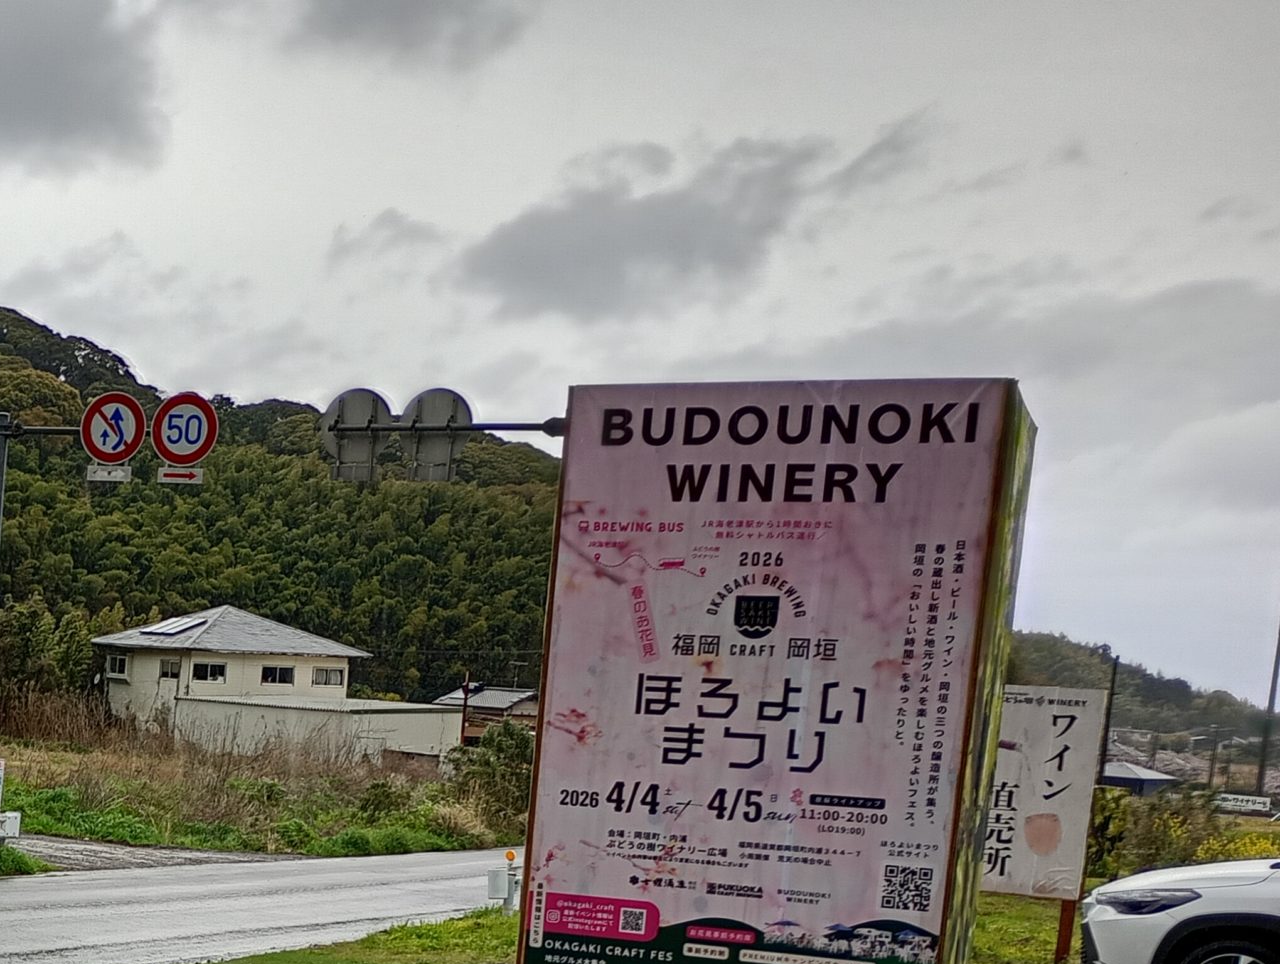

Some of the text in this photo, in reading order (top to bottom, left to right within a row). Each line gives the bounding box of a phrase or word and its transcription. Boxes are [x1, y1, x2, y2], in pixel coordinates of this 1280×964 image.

[166, 413, 203, 445] 50
[601, 402, 981, 447] BUDOUNOKI
[666, 462, 903, 504] WINERY
[593, 521, 684, 533] BREWING BUS
[738, 551, 784, 567] 2026
[706, 573, 807, 618] OKAGAKI BREWING
[631, 585, 656, 657] 春のお花見
[672, 633, 839, 661] 福岡 CRAFT 岡垣
[635, 673, 867, 725] ほろよい
[1047, 698, 1088, 708] WINERY
[661, 722, 826, 774] まつり
[1042, 713, 1079, 801] ワイン
[559, 789, 600, 808] 2026
[605, 781, 660, 815] 4/4
[706, 787, 764, 823] 4/5
[770, 793, 778, 803] 日
[799, 808, 888, 825] 11:00-20:00
[983, 781, 1020, 877] 直売所
[817, 824, 866, 836] (LO19:00)
[606, 840, 728, 858] ぶどうの樹ワイナリー広場
[880, 840, 939, 851] ほろよいまつり
[717, 882, 764, 894] FUKUOKA
[776, 888, 832, 899] BUDOUNOKI
[786, 896, 820, 905] WINERY
[545, 939, 674, 962] OKAGAKI CRAFT FES
